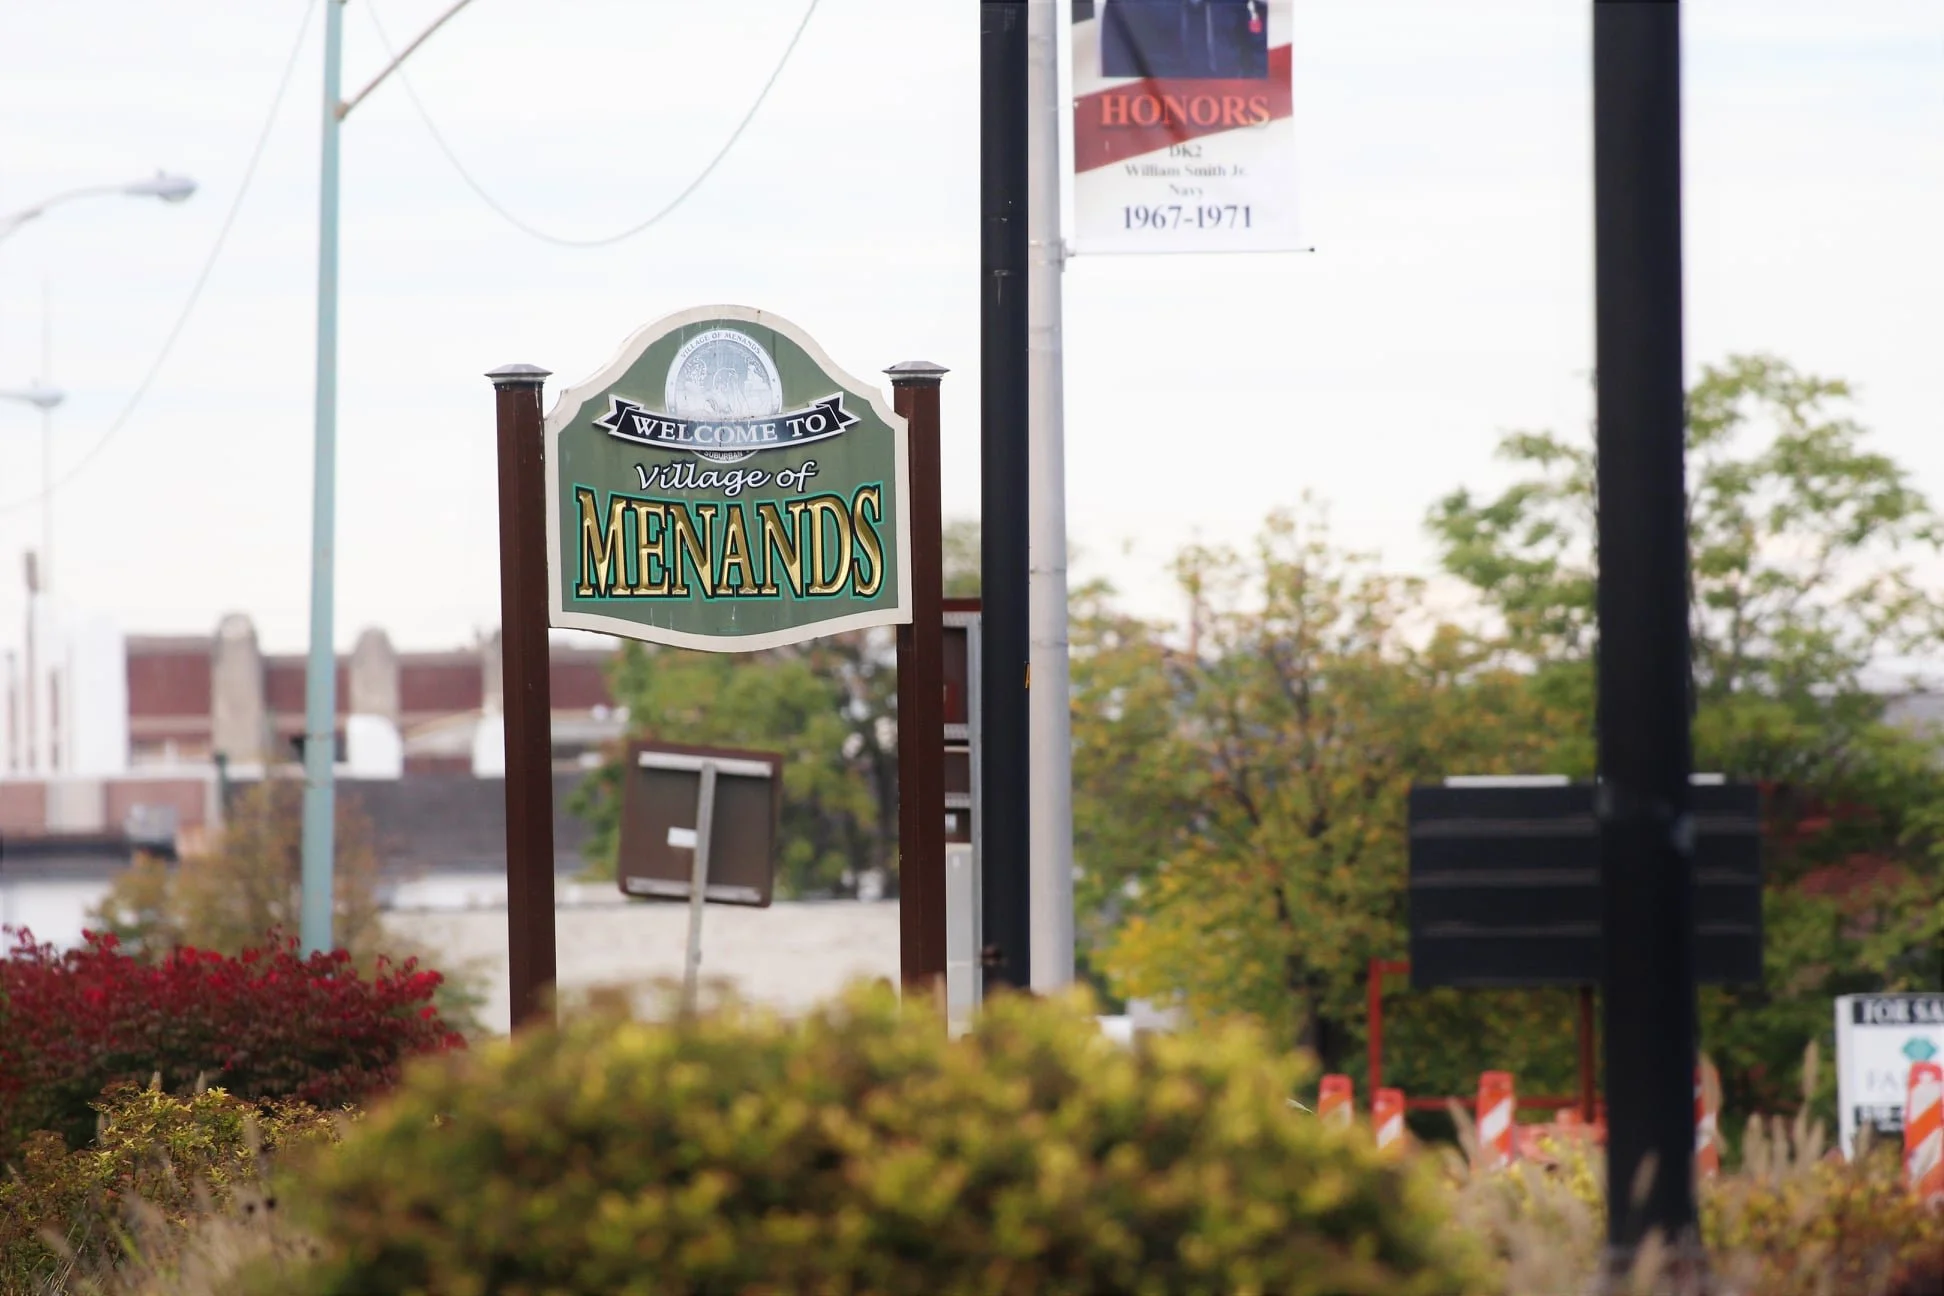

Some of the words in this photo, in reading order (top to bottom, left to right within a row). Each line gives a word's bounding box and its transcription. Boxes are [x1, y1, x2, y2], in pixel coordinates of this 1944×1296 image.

[1101, 94, 1271, 126] HONORS
[1125, 164, 1180, 176] William
[1185, 164, 1226, 176] Smith
[1168, 183, 1204, 198] Navy
[1123, 204, 1252, 229] 1967-1971
[681, 334, 710, 358] VILLAGE
[712, 331, 720, 339] OF
[724, 332, 760, 354] MENANDS
[632, 415, 777, 444] WELCOME
[786, 414, 827, 438] TO
[635, 463, 771, 497] Village
[776, 462, 817, 491] of
[574, 482, 884, 600] MENANDS
